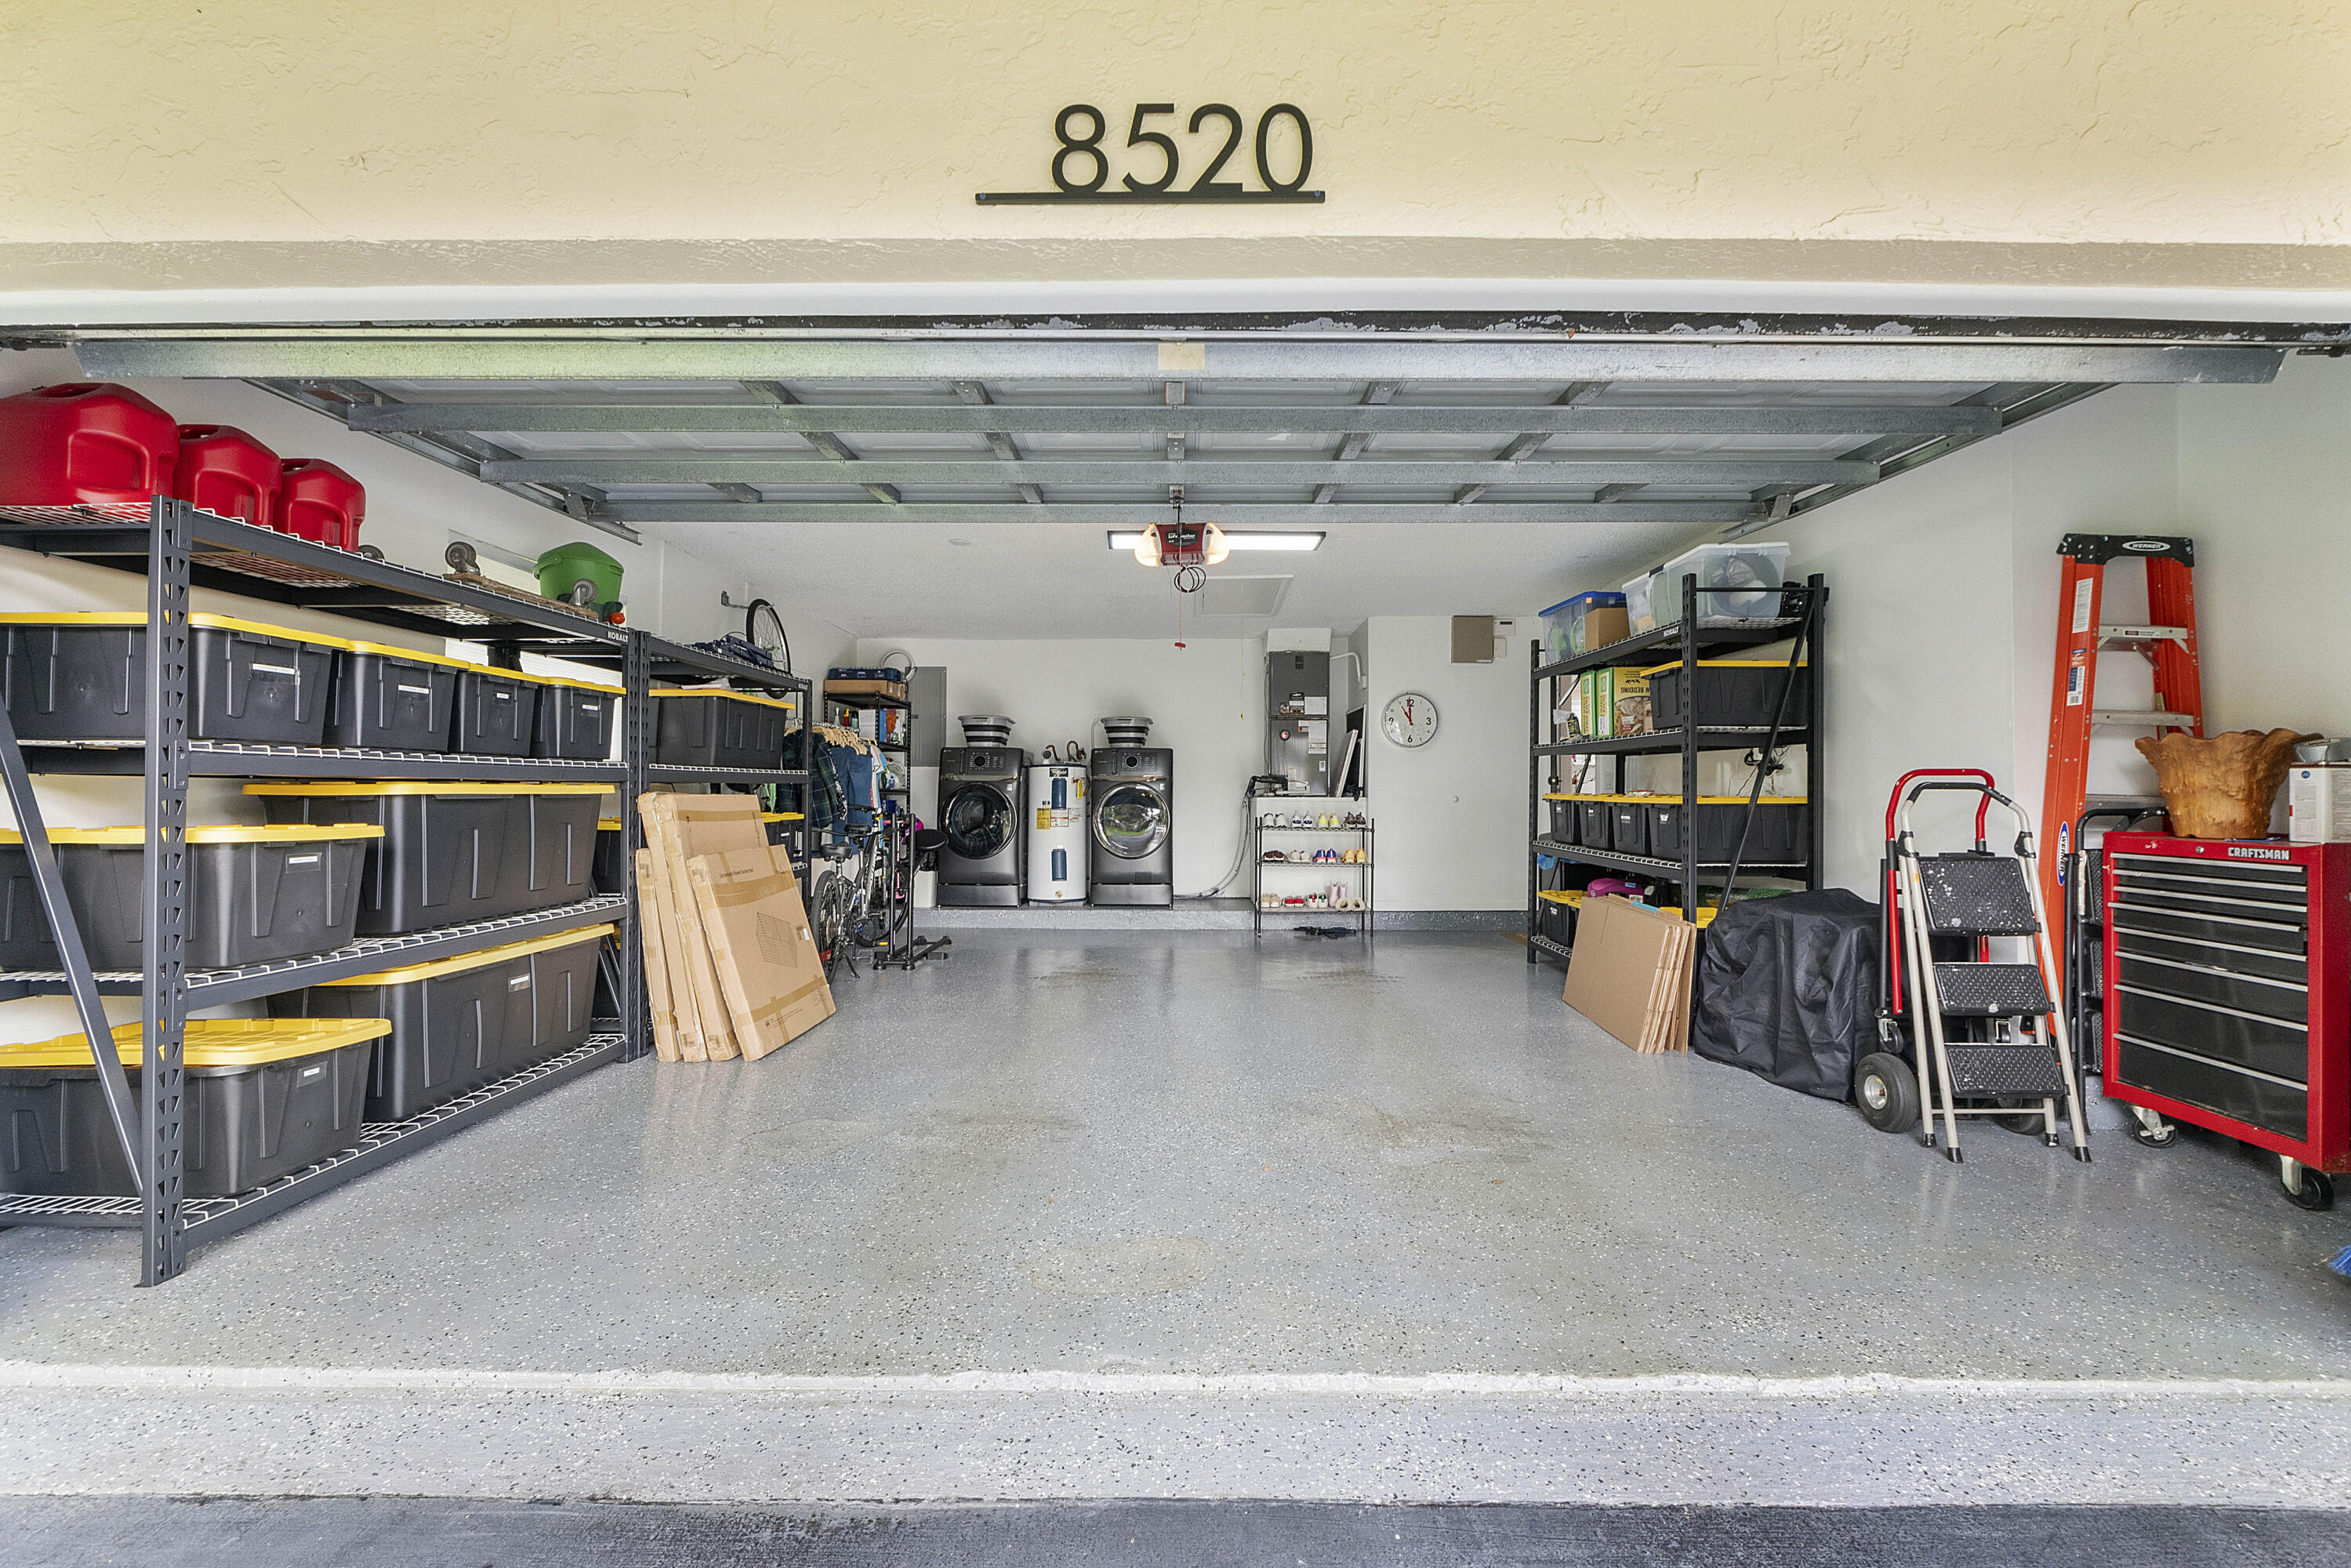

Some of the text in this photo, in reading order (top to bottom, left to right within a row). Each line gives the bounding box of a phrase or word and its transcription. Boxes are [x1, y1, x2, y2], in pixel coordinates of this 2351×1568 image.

[1050, 103, 1313, 193] 8520
[608, 630, 629, 643] KOBALT
[1406, 699, 1415, 707] 12
[1388, 717, 1394, 726] 9
[1426, 717, 1431, 725] 3
[2227, 847, 2290, 861] CRAFTSMAN
